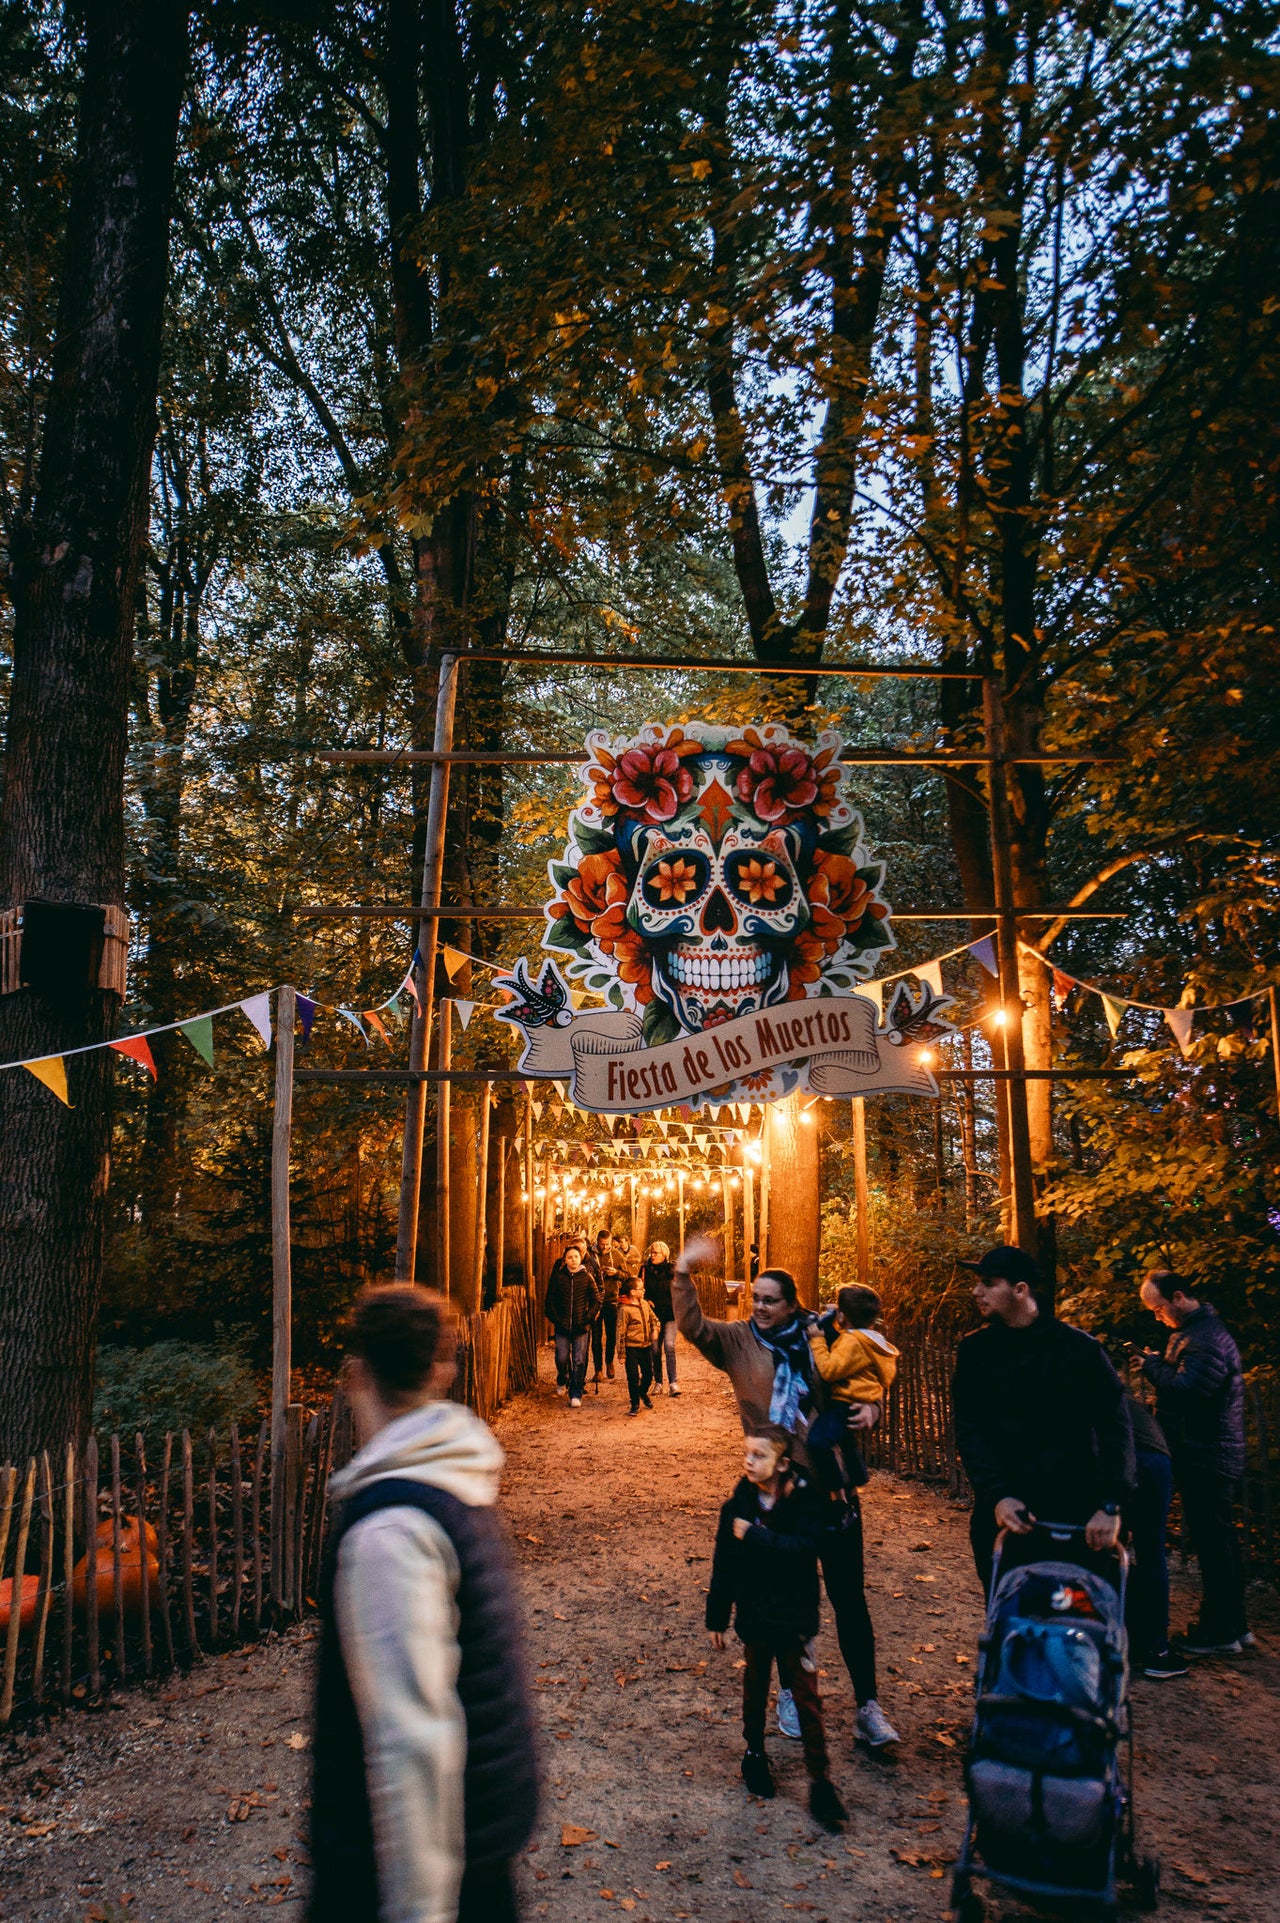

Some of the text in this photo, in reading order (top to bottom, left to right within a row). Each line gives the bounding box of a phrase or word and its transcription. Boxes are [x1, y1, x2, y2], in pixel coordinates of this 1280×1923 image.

[607, 1009, 851, 1101] Fiesta de los Muertos
